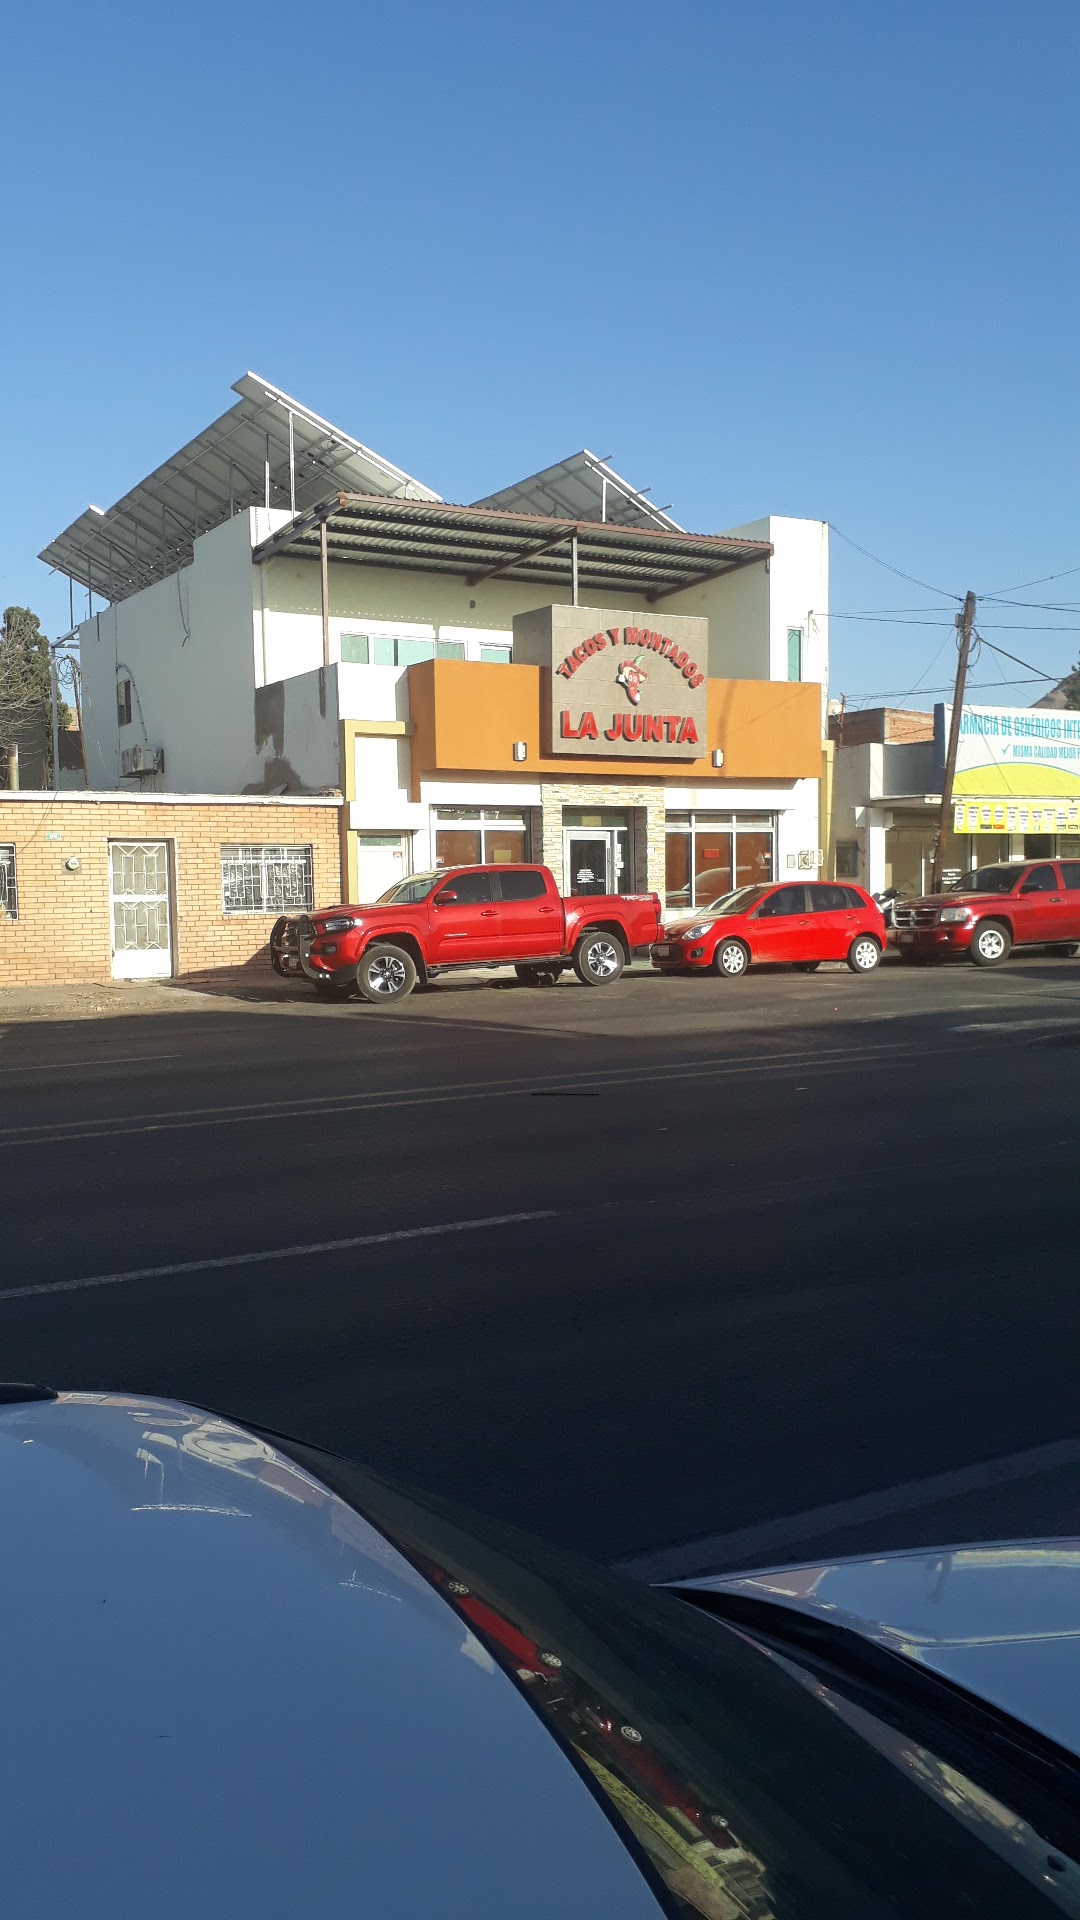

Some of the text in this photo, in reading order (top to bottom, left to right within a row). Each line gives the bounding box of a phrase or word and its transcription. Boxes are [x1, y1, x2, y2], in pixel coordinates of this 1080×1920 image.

[556, 627, 705, 689] TACOS Y MONTADOS
[560, 710, 698, 743] LA JUNTA
[960, 714, 999, 736] ARMACIA
[1001, 716, 1012, 737] DE
[1014, 714, 1062, 739] GENÉRICOS
[1013, 744, 1033, 758] MISMA
